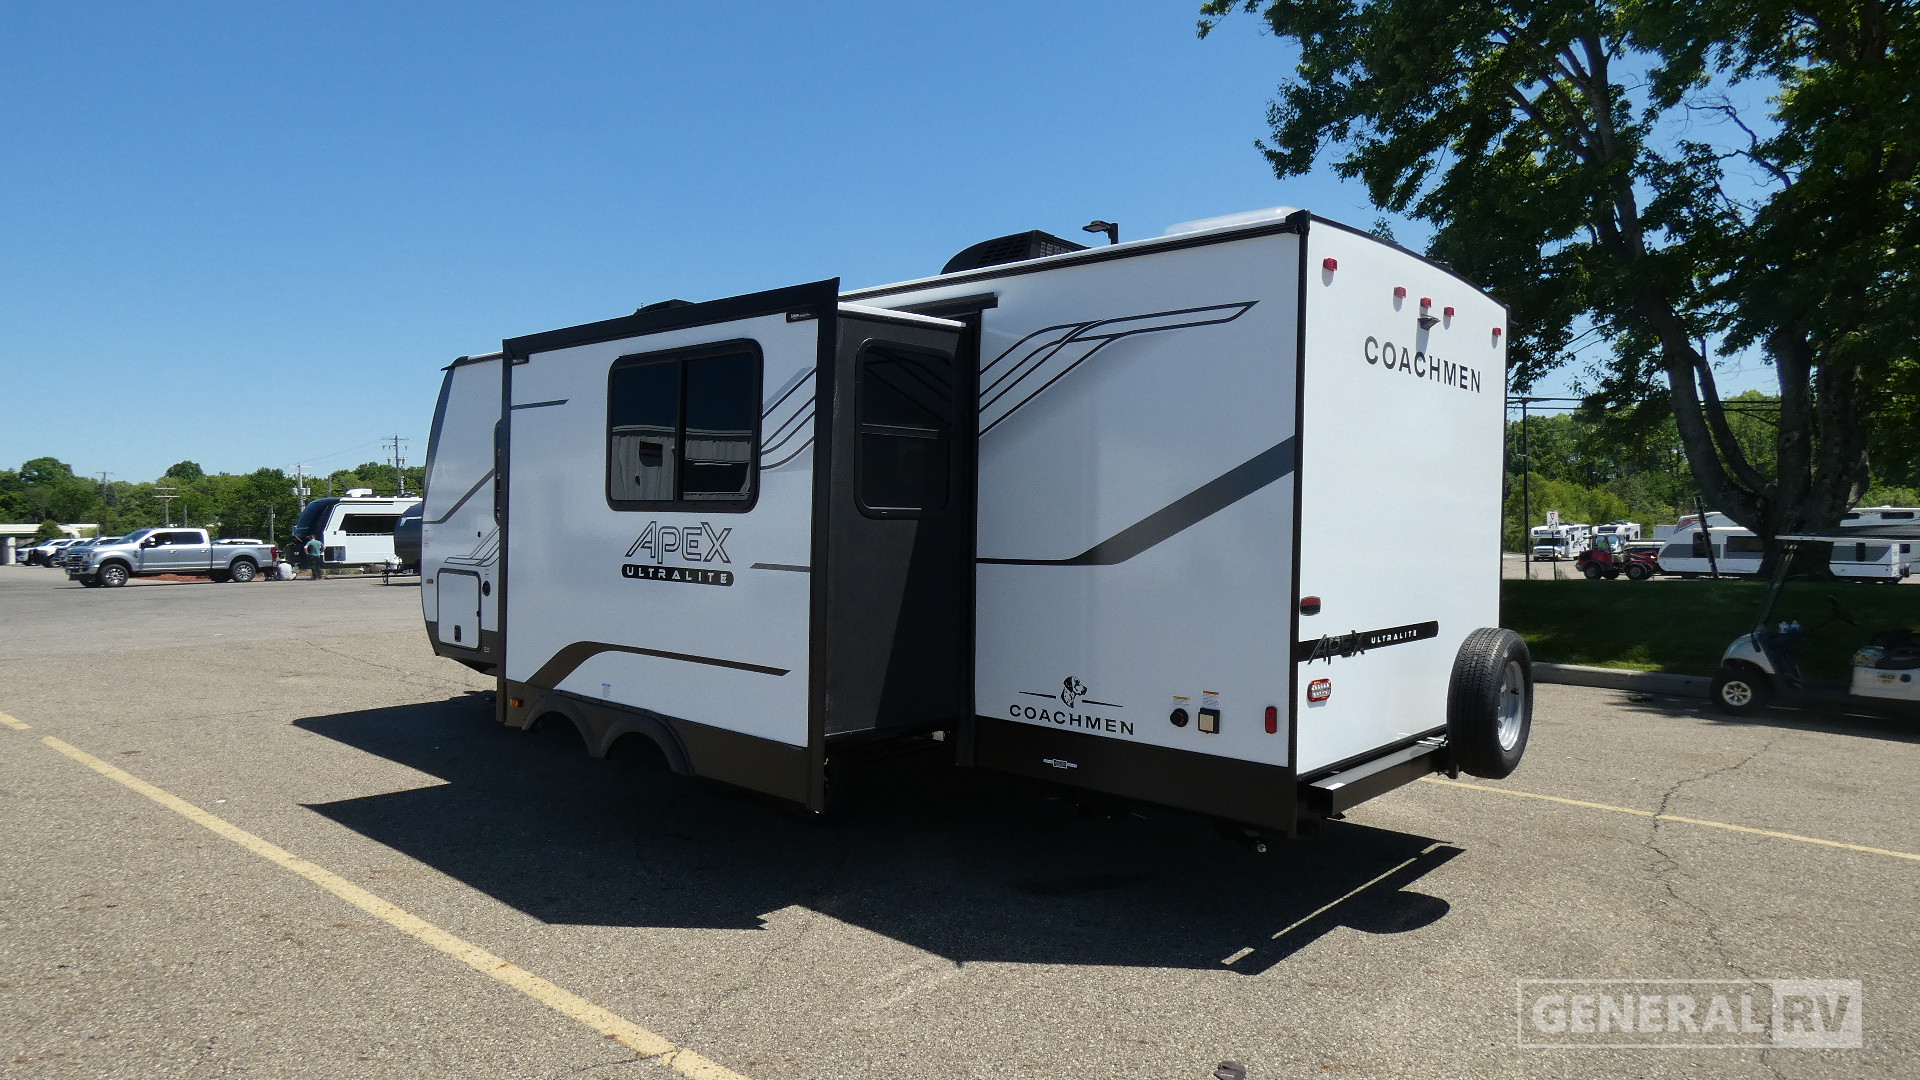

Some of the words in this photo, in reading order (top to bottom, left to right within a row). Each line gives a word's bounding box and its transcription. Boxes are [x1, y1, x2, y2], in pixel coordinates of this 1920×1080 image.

[1364, 335, 1480, 393] COACHMEN
[625, 520, 732, 564] APEX
[626, 566, 728, 584] ULTRALITE
[1307, 629, 1365, 665] APEX
[1371, 629, 1417, 644] ULTRALITE
[1009, 704, 1134, 735] COACHMEN
